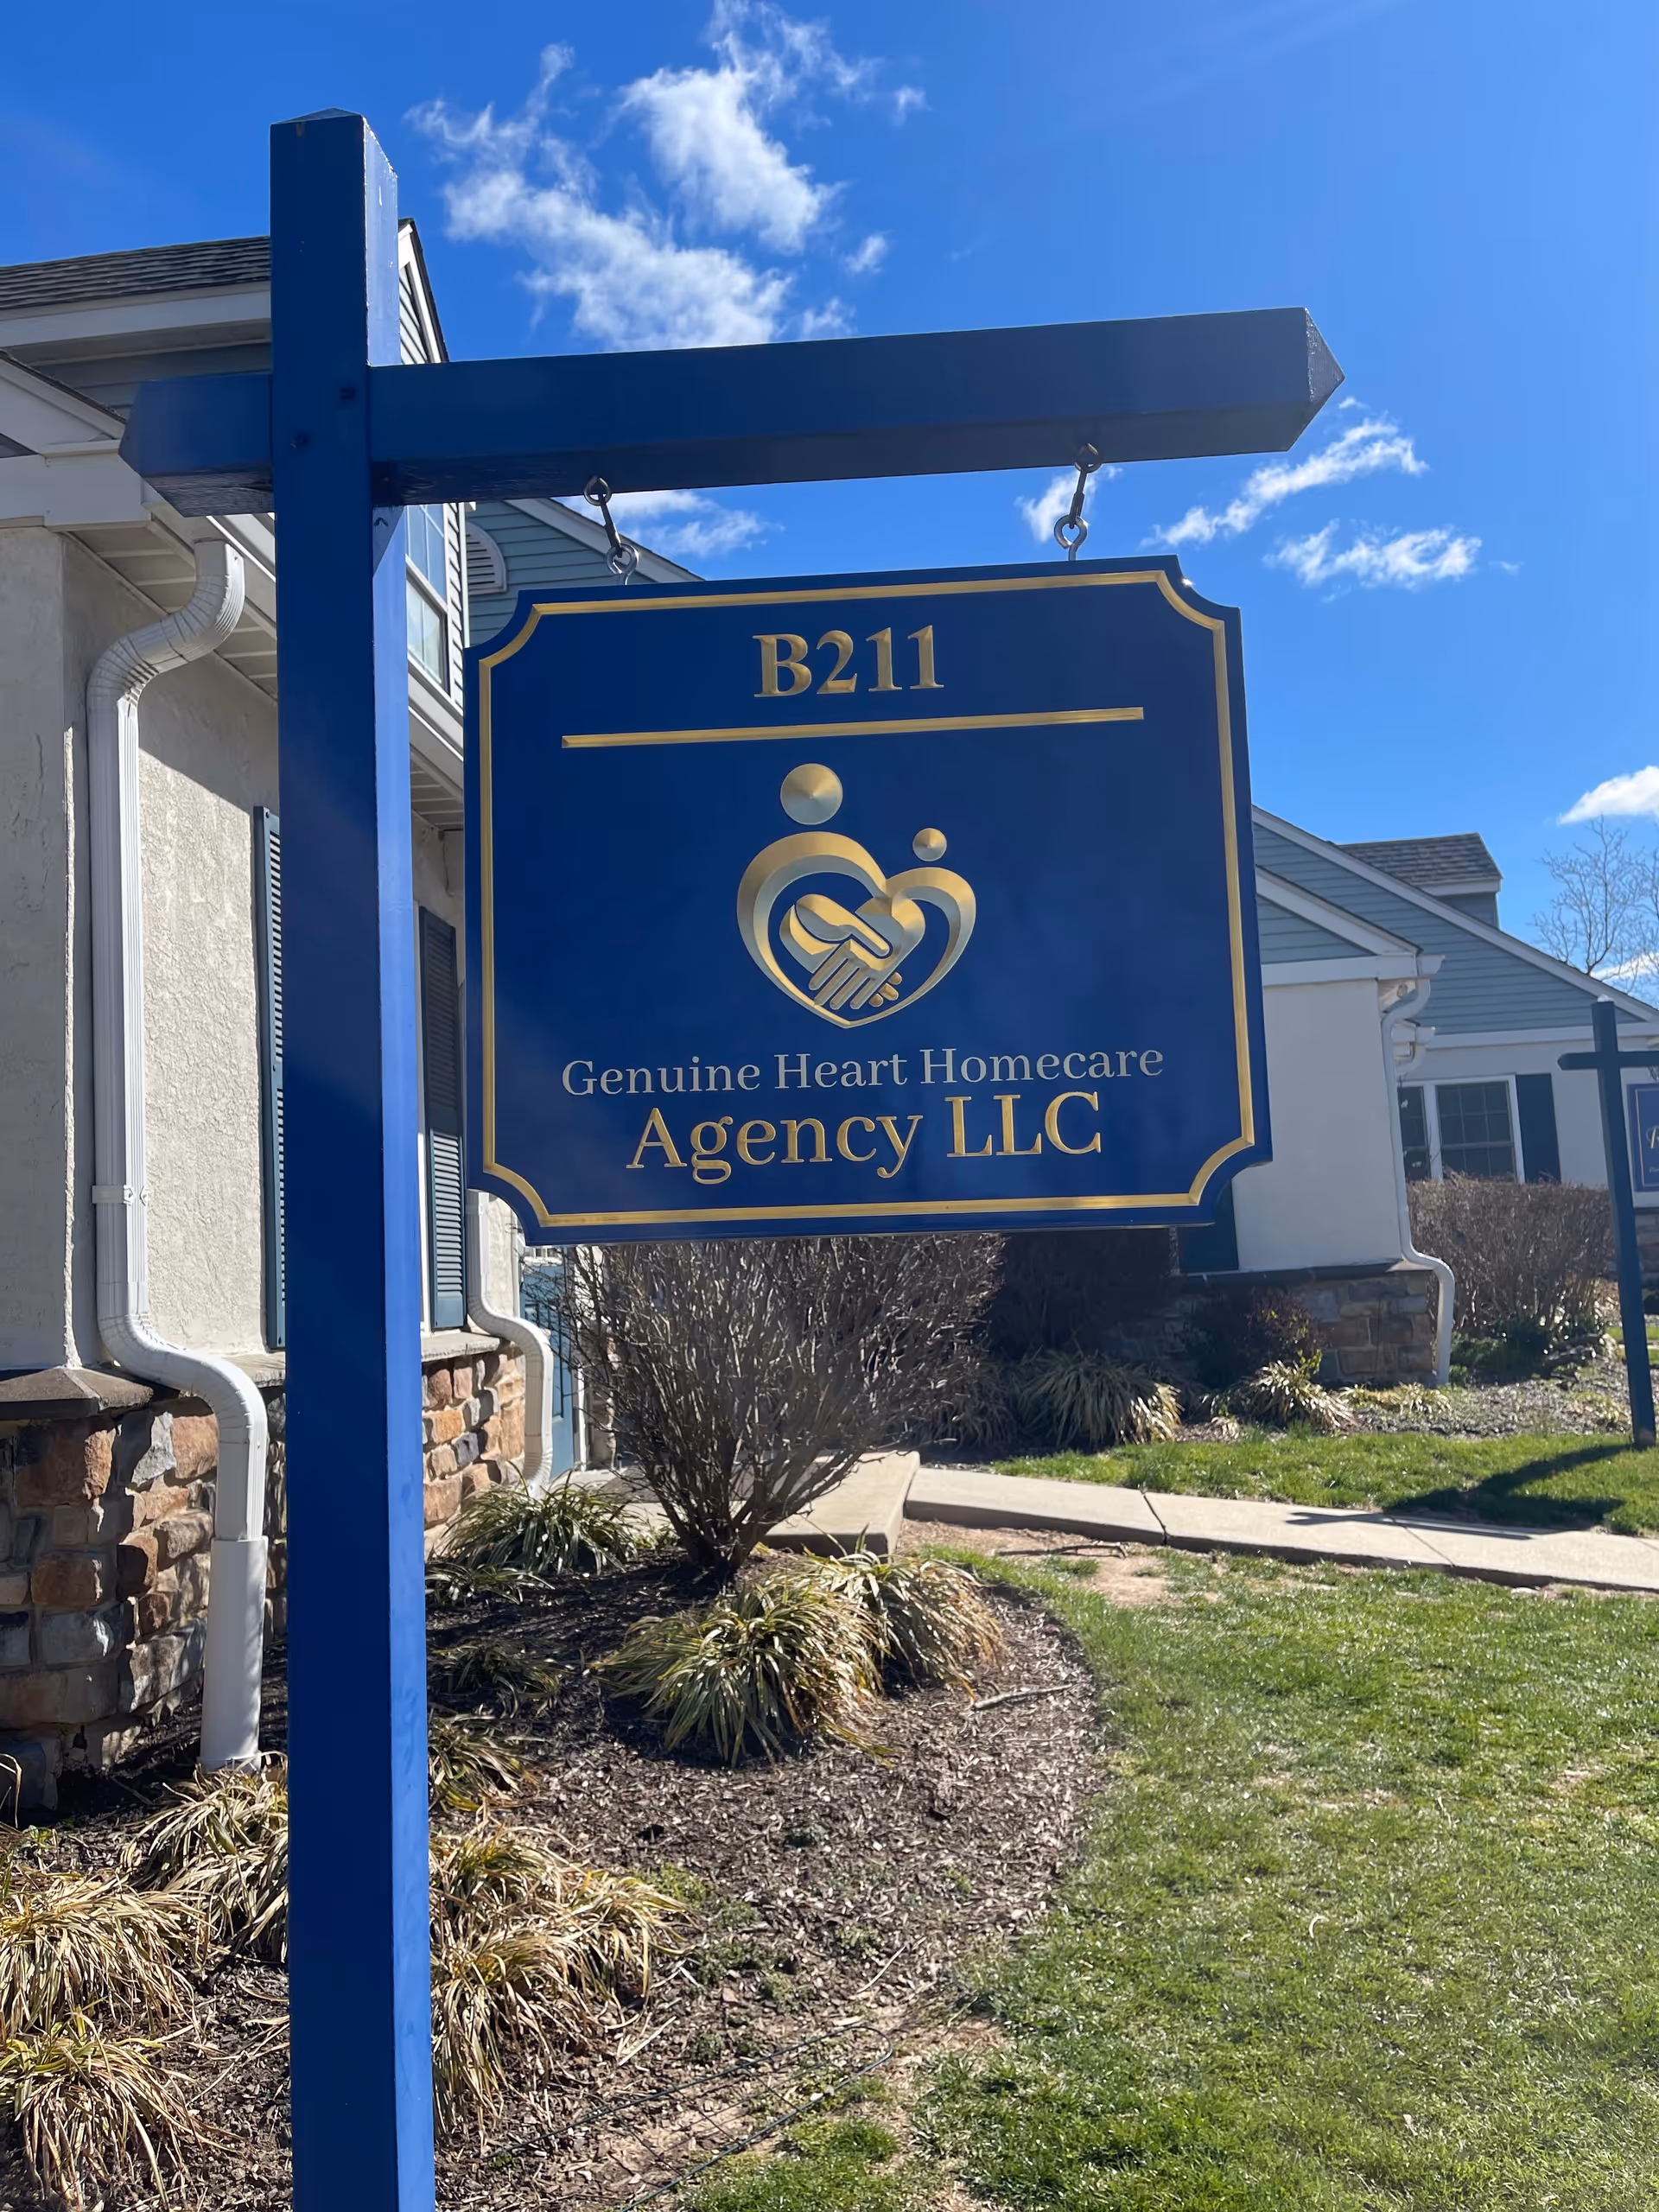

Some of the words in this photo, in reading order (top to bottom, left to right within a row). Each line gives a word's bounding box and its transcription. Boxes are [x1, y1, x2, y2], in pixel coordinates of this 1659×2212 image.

[752, 625, 944, 697] B211
[562, 1056, 760, 1096] Genuine
[773, 1053, 908, 1089] Heart
[919, 1048, 1163, 1084] Homecare
[626, 1107, 924, 1185] Agency
[944, 1090, 1102, 1158] LLC
